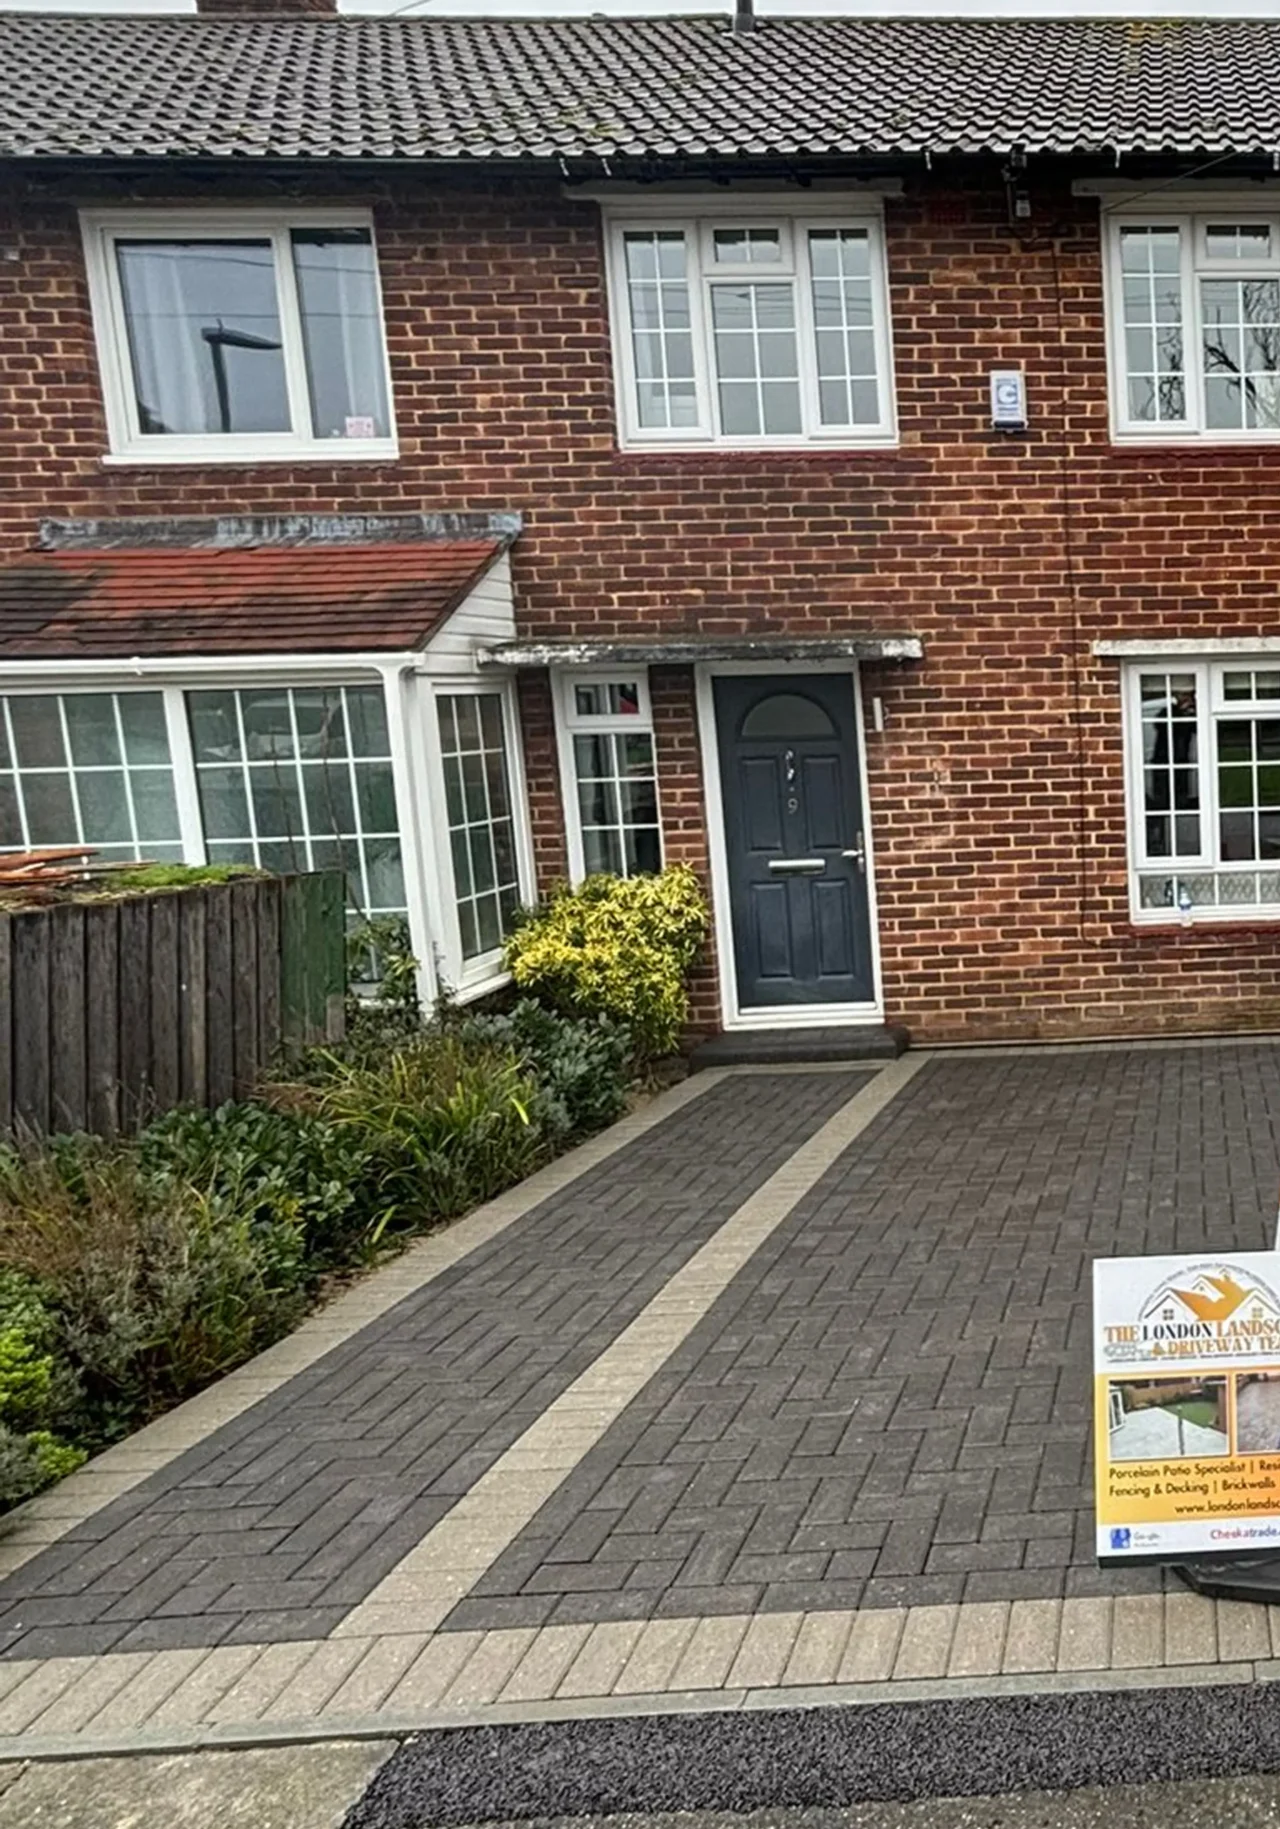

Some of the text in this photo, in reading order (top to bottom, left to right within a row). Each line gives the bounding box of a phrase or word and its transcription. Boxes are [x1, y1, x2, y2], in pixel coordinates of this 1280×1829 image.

[788, 798, 798, 815] 9
[1104, 1325, 1140, 1342] THE
[1142, 1323, 1213, 1341] LONDON
[1152, 1342, 1164, 1357] &
[1167, 1337, 1255, 1354] DRIVEWAY
[1109, 1459, 1246, 1479] Porcelain Patio Specialist
[1109, 1481, 1209, 1498] Fencing & Decking
[1221, 1475, 1276, 1490] Brickwalls
